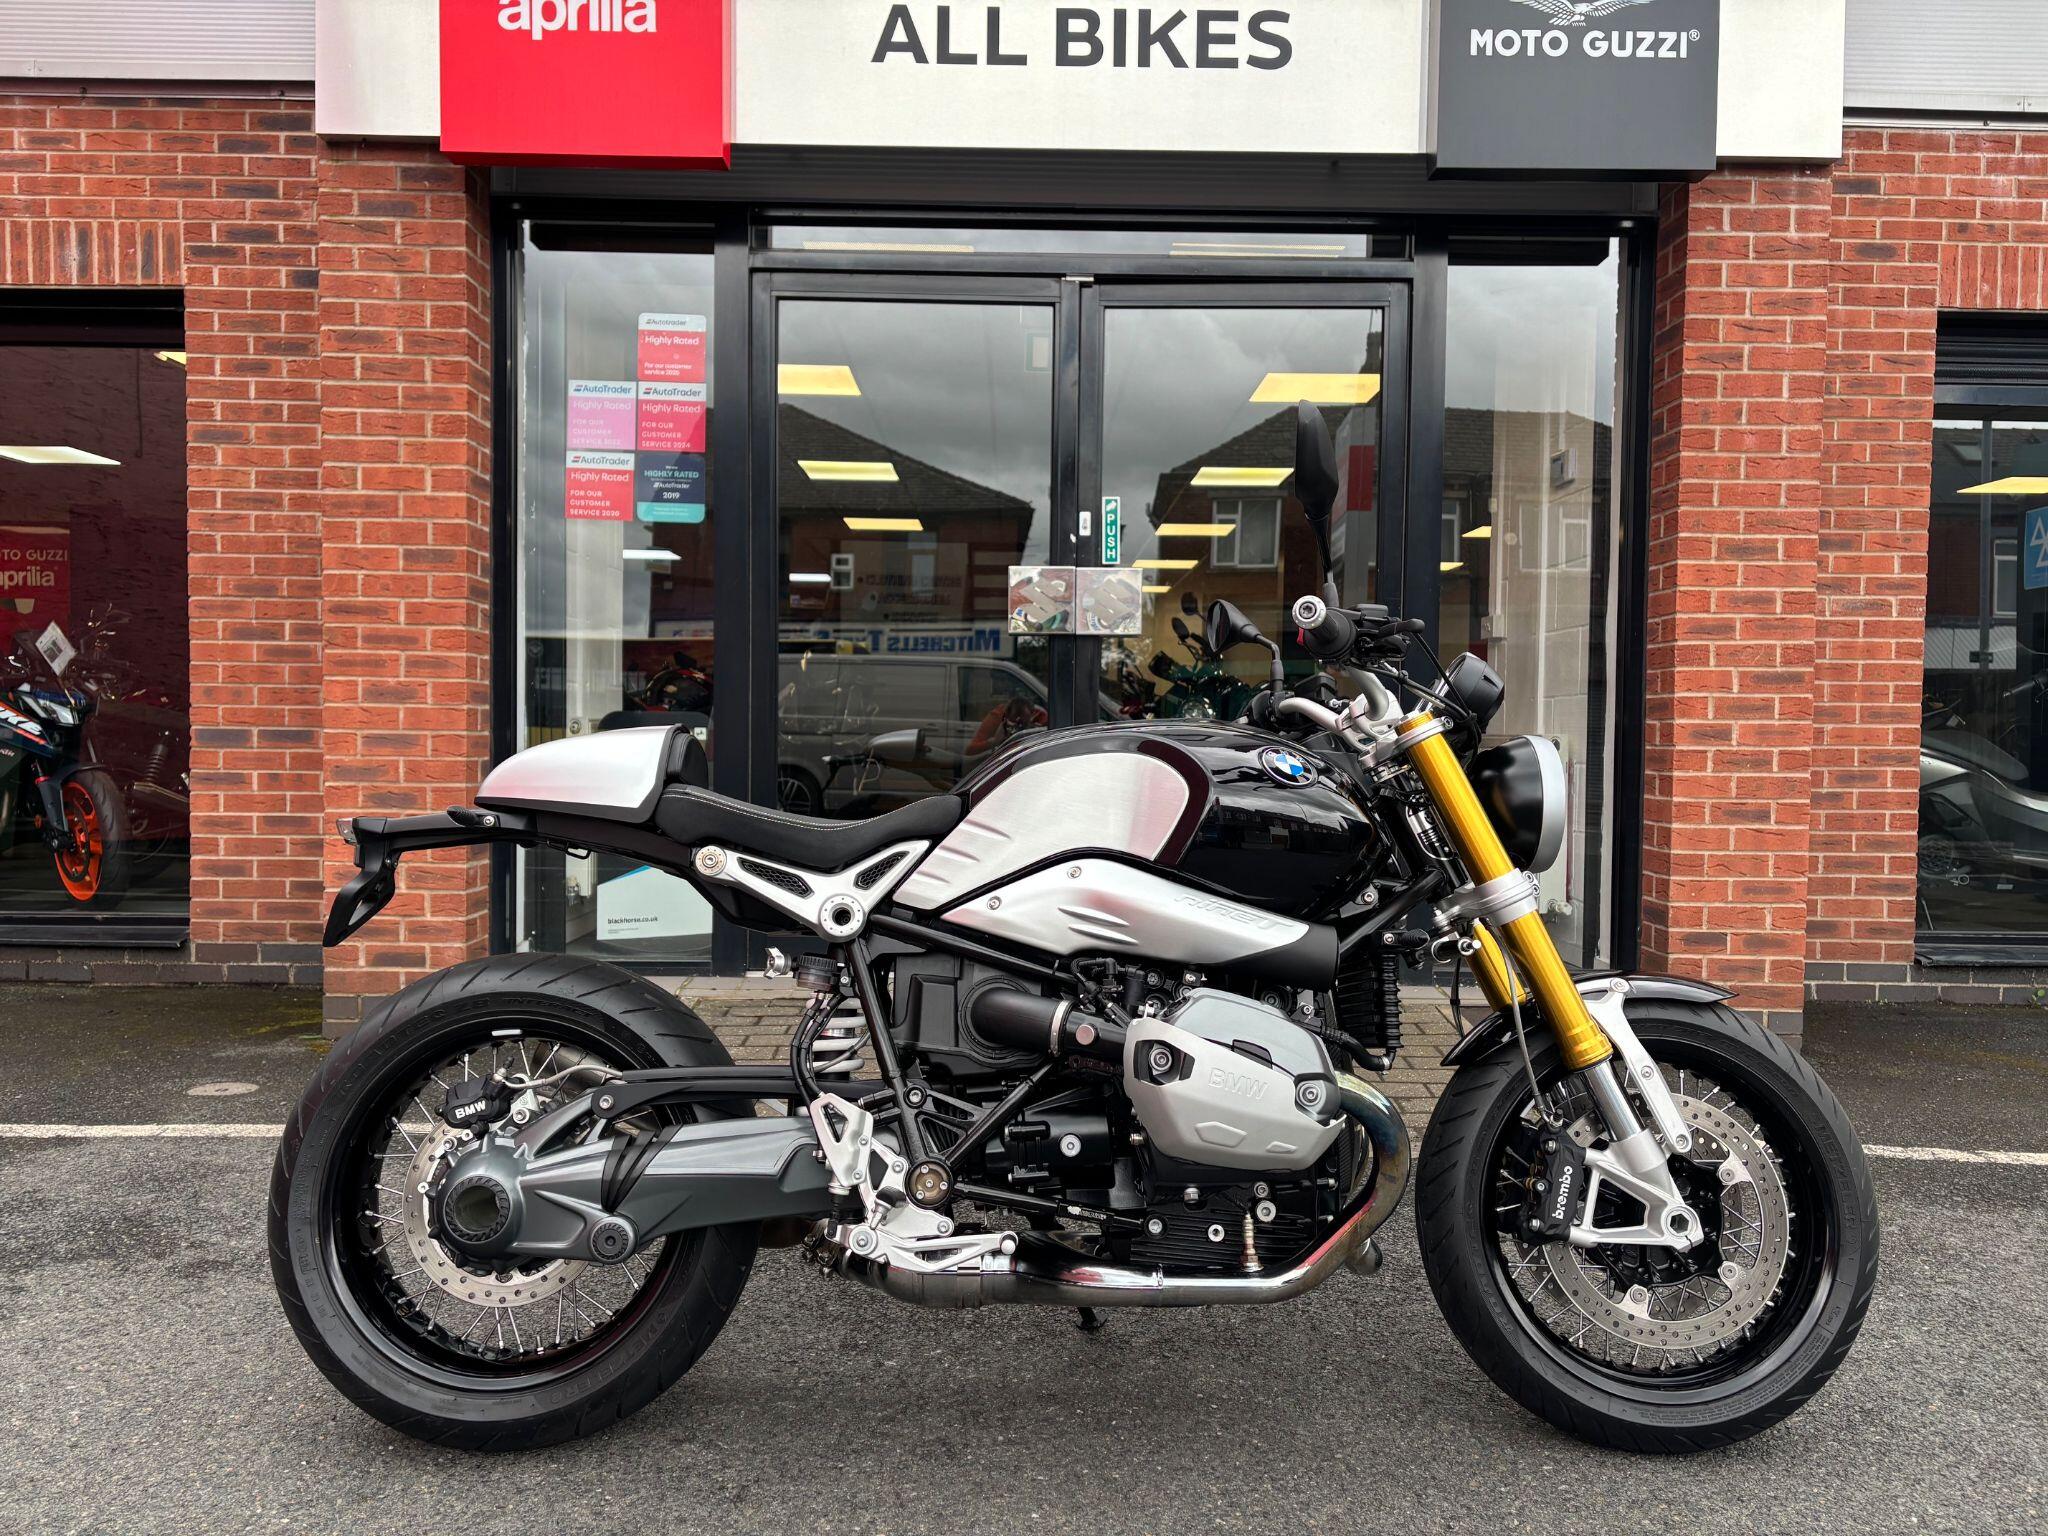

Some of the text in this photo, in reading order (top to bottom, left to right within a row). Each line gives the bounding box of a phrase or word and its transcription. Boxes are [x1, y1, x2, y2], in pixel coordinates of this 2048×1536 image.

[497, 0, 658, 40] aprilia
[871, 4, 1293, 70] ALL BIKES
[1470, 29, 1569, 57] MOTO
[645, 335, 699, 346] Highly Rated
[582, 384, 632, 394] AutoTrader
[652, 387, 702, 397] AutoTrader
[573, 400, 632, 411] Highly Rated
[642, 403, 701, 414] Highly Rated
[641, 430, 682, 439] CUSTOMER
[641, 440, 672, 448] SERVICE
[580, 456, 630, 465] AutoTrader
[571, 471, 629, 482] Highly Rated
[644, 470, 700, 479] HIGHLY RATED
[662, 491, 681, 499] 2019
[570, 499, 610, 507] CUSTOMER
[570, 508, 600, 516] SERVICE
[1106, 513, 1116, 559] PUSH
[26, 548, 68, 561] GUZZI
[0, 566, 55, 590] prilia
[607, 916, 659, 925] blackhorse.co.uk
[1208, 1067, 1269, 1101] BMW
[454, 1100, 486, 1119] BMW
[1551, 1165, 1573, 1220] brembo
